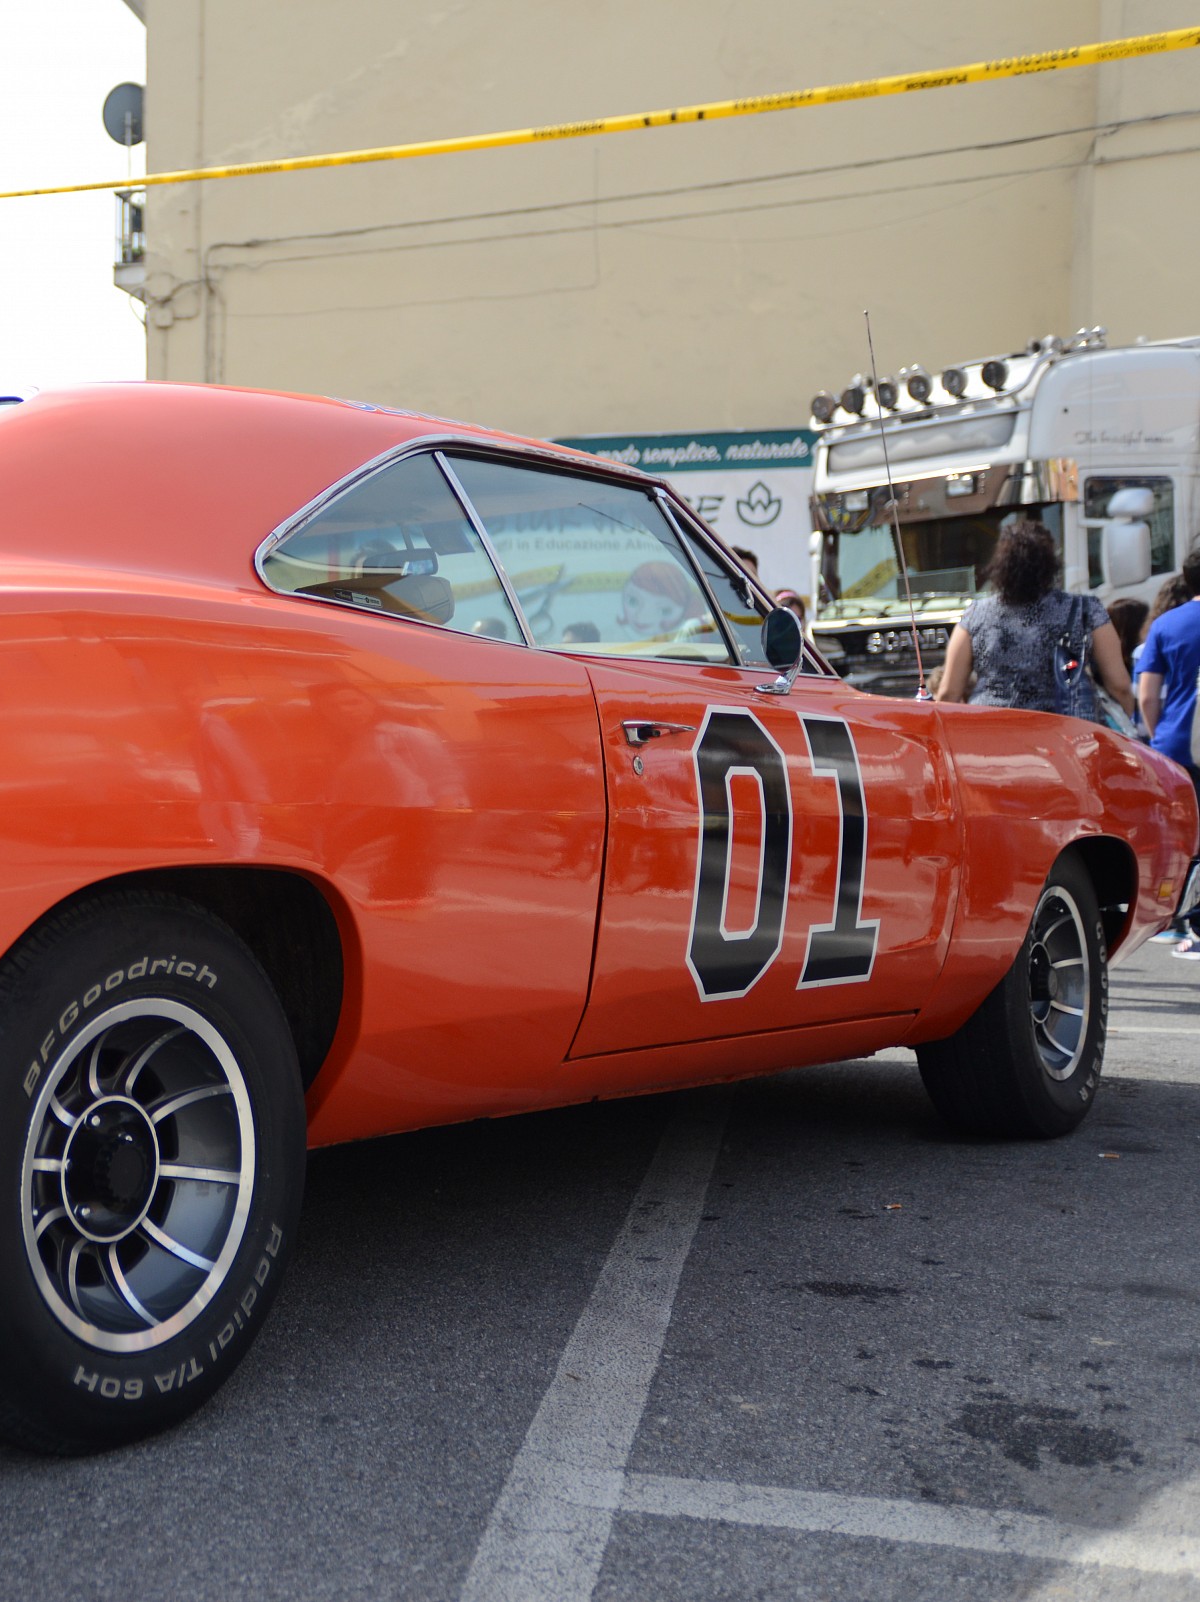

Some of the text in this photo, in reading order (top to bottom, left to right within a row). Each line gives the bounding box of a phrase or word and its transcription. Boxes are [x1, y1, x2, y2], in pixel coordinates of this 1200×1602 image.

[642, 441, 721, 468] semplice,
[725, 436, 810, 461] naturale
[534, 535, 621, 553] Educazione
[866, 627, 950, 654] SCANIA
[685, 704, 881, 1002] 01
[73, 1223, 283, 1400] Radial T/A 60H
